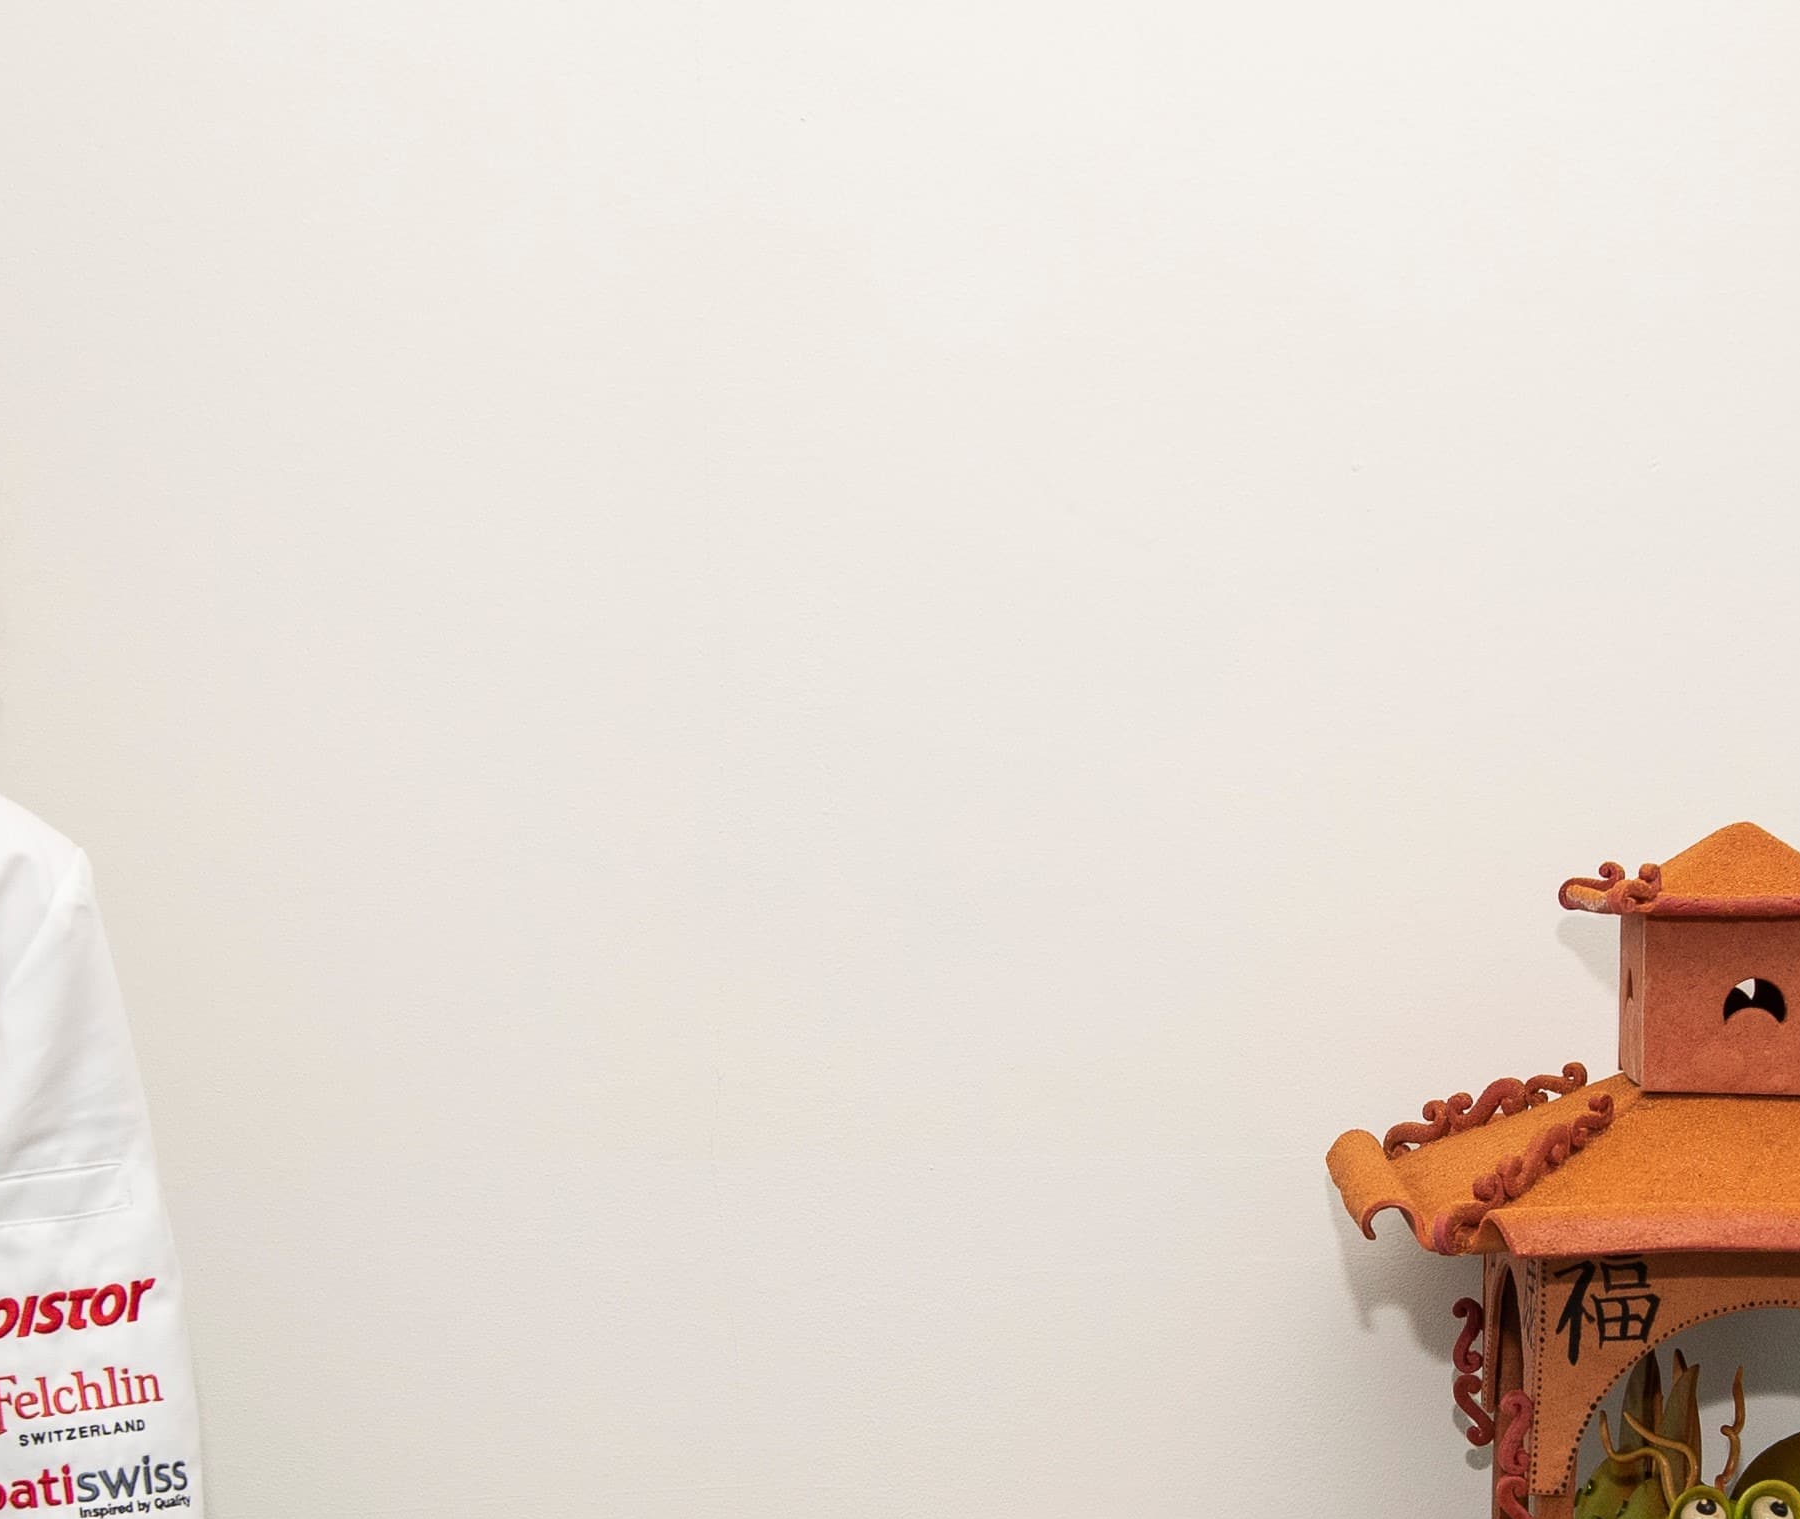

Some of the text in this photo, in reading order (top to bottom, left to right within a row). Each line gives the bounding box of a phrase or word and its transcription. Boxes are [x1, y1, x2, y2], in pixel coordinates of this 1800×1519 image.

[1554, 1254, 1661, 1366] 福
[19, 1419, 146, 1447] SWITZERLAND
[79, 1494, 191, 1519] Inspired by Quality
